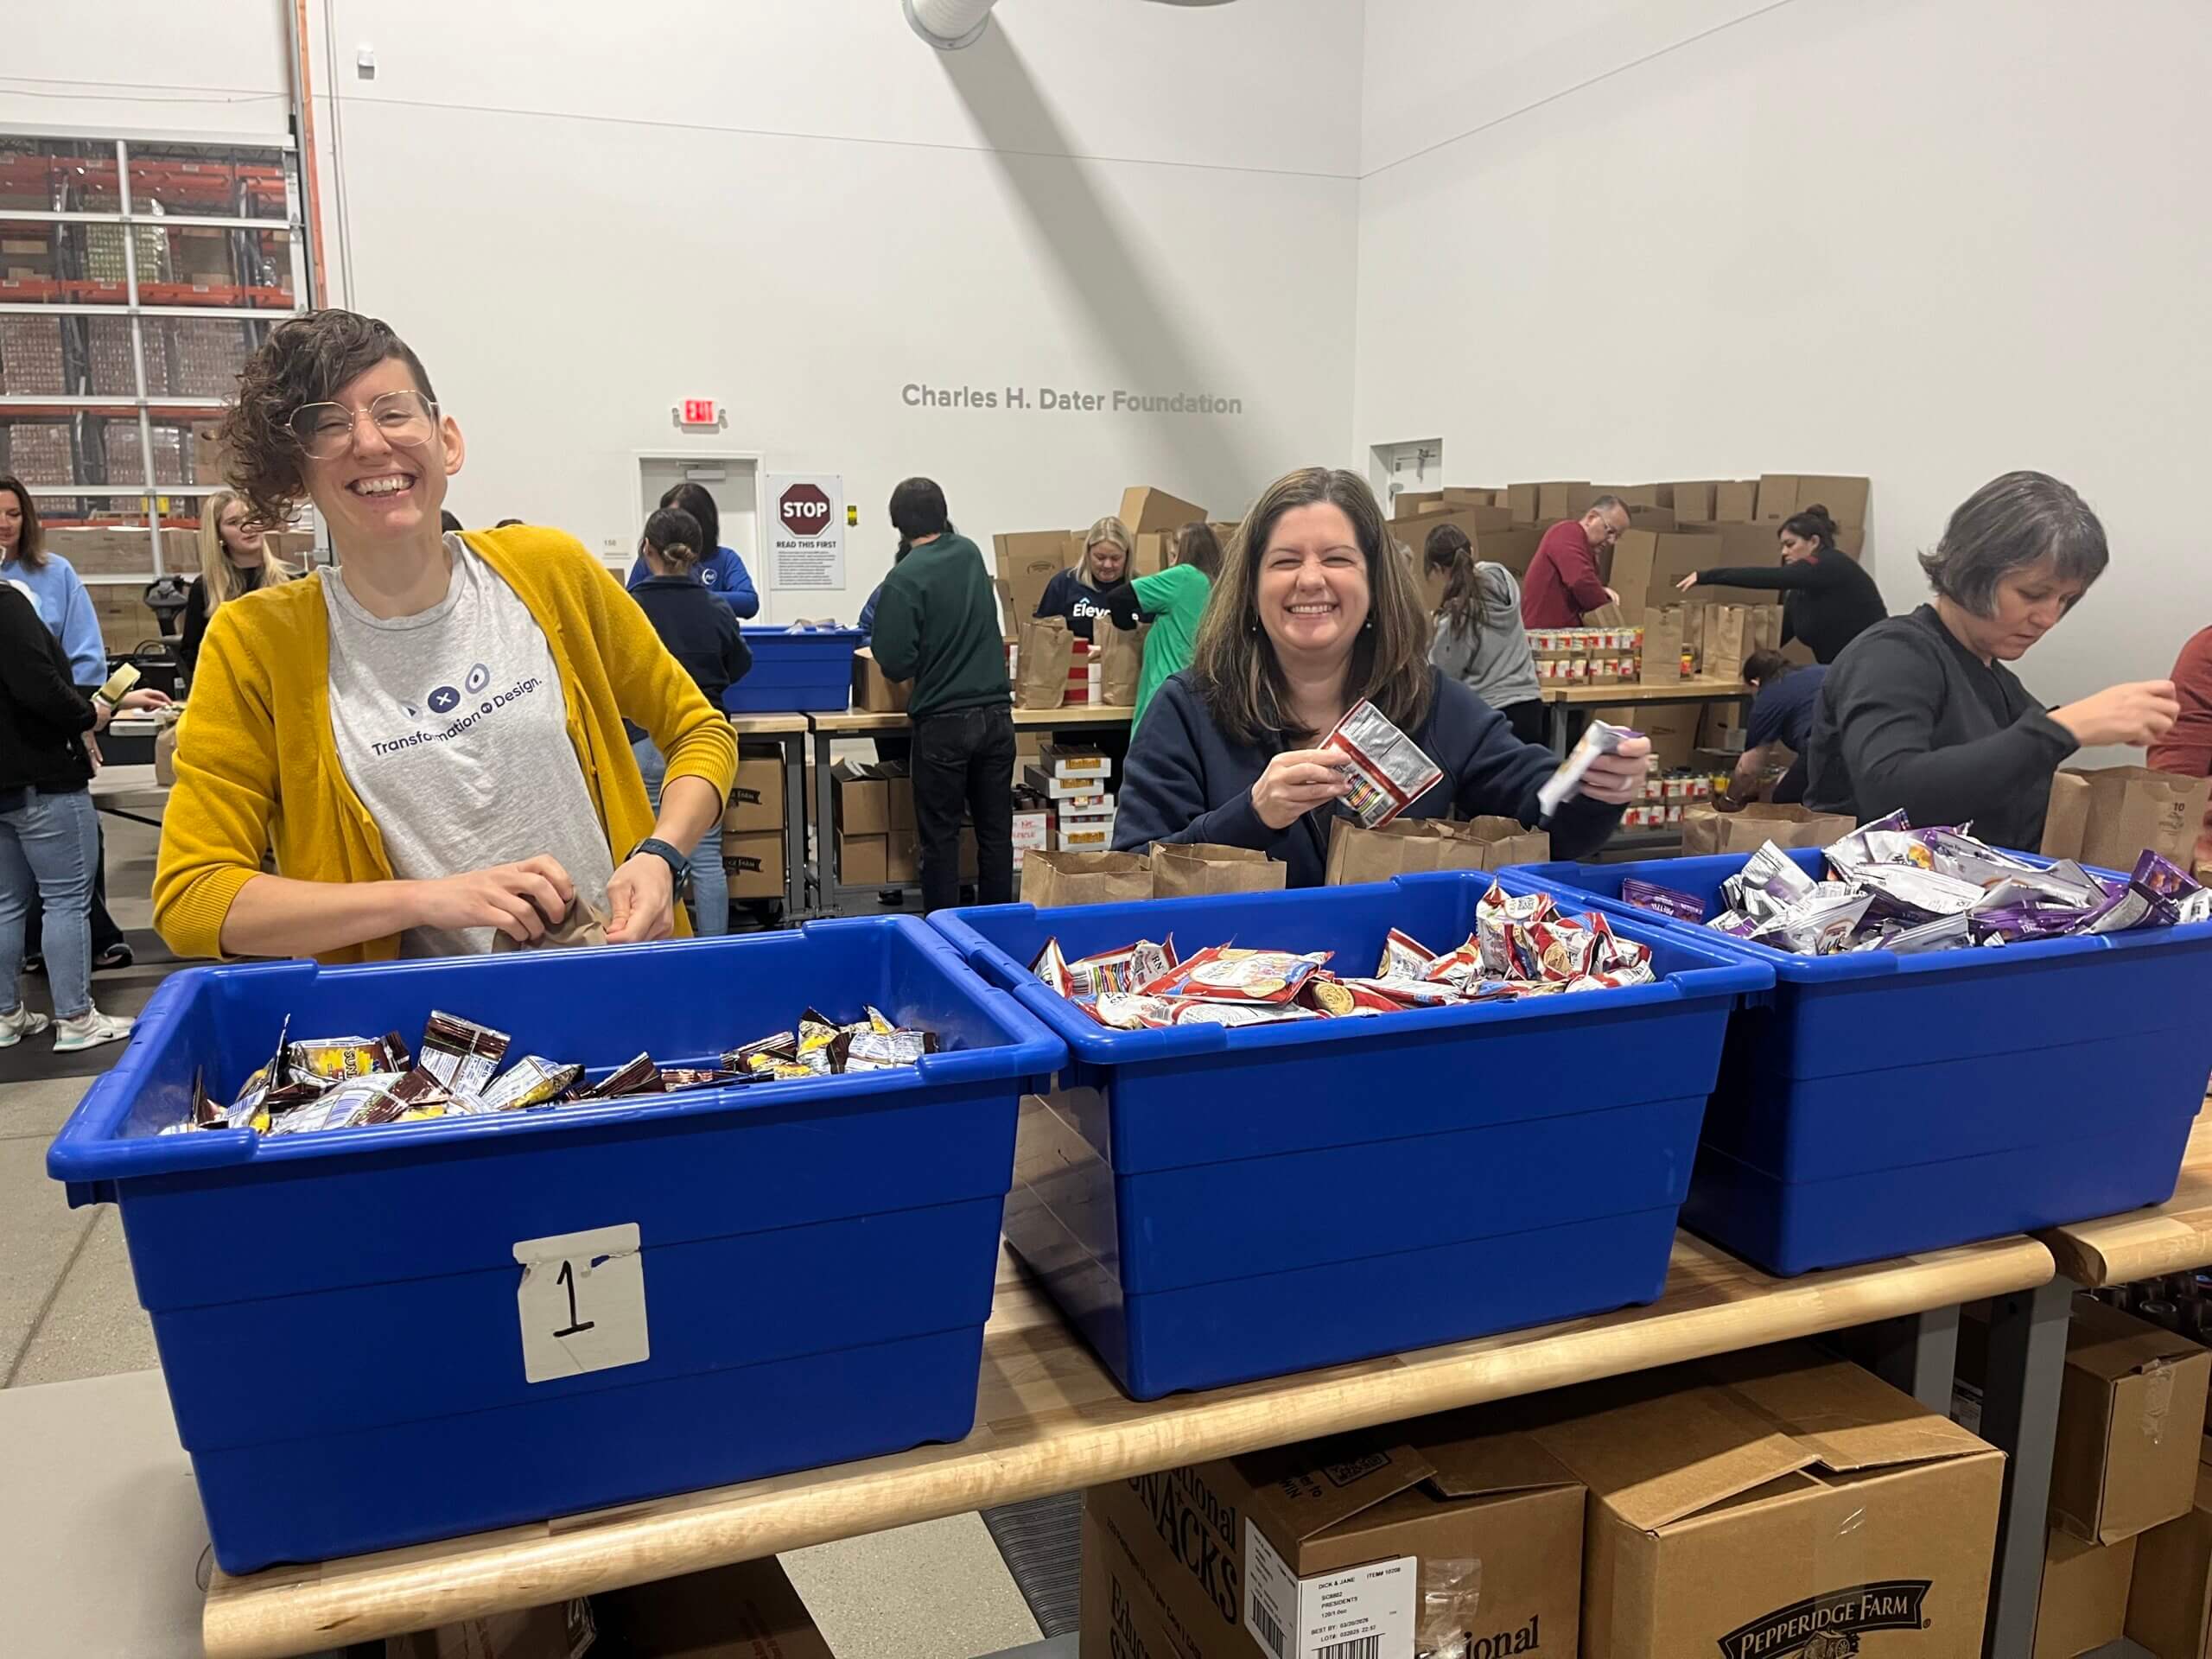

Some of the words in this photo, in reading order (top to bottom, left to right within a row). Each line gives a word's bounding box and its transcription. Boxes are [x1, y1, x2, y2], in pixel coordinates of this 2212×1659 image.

[902, 384, 997, 408] Charles
[1006, 387, 1032, 410] H.
[1039, 388, 1105, 411] Dater
[1112, 391, 1243, 415] Foundation
[685, 400, 714, 422] EXIT
[783, 501, 828, 518] STOP
[493, 676, 543, 709] Design.
[553, 1260, 594, 1338] 1
[1339, 1577, 1355, 1586] JANE
[1367, 1570, 1384, 1580] ITEM#
[1321, 1597, 1357, 1609] PRESIDENTS
[1741, 1603, 1856, 1659] PEPPERIDGE
[1860, 1594, 1908, 1621] FARM
